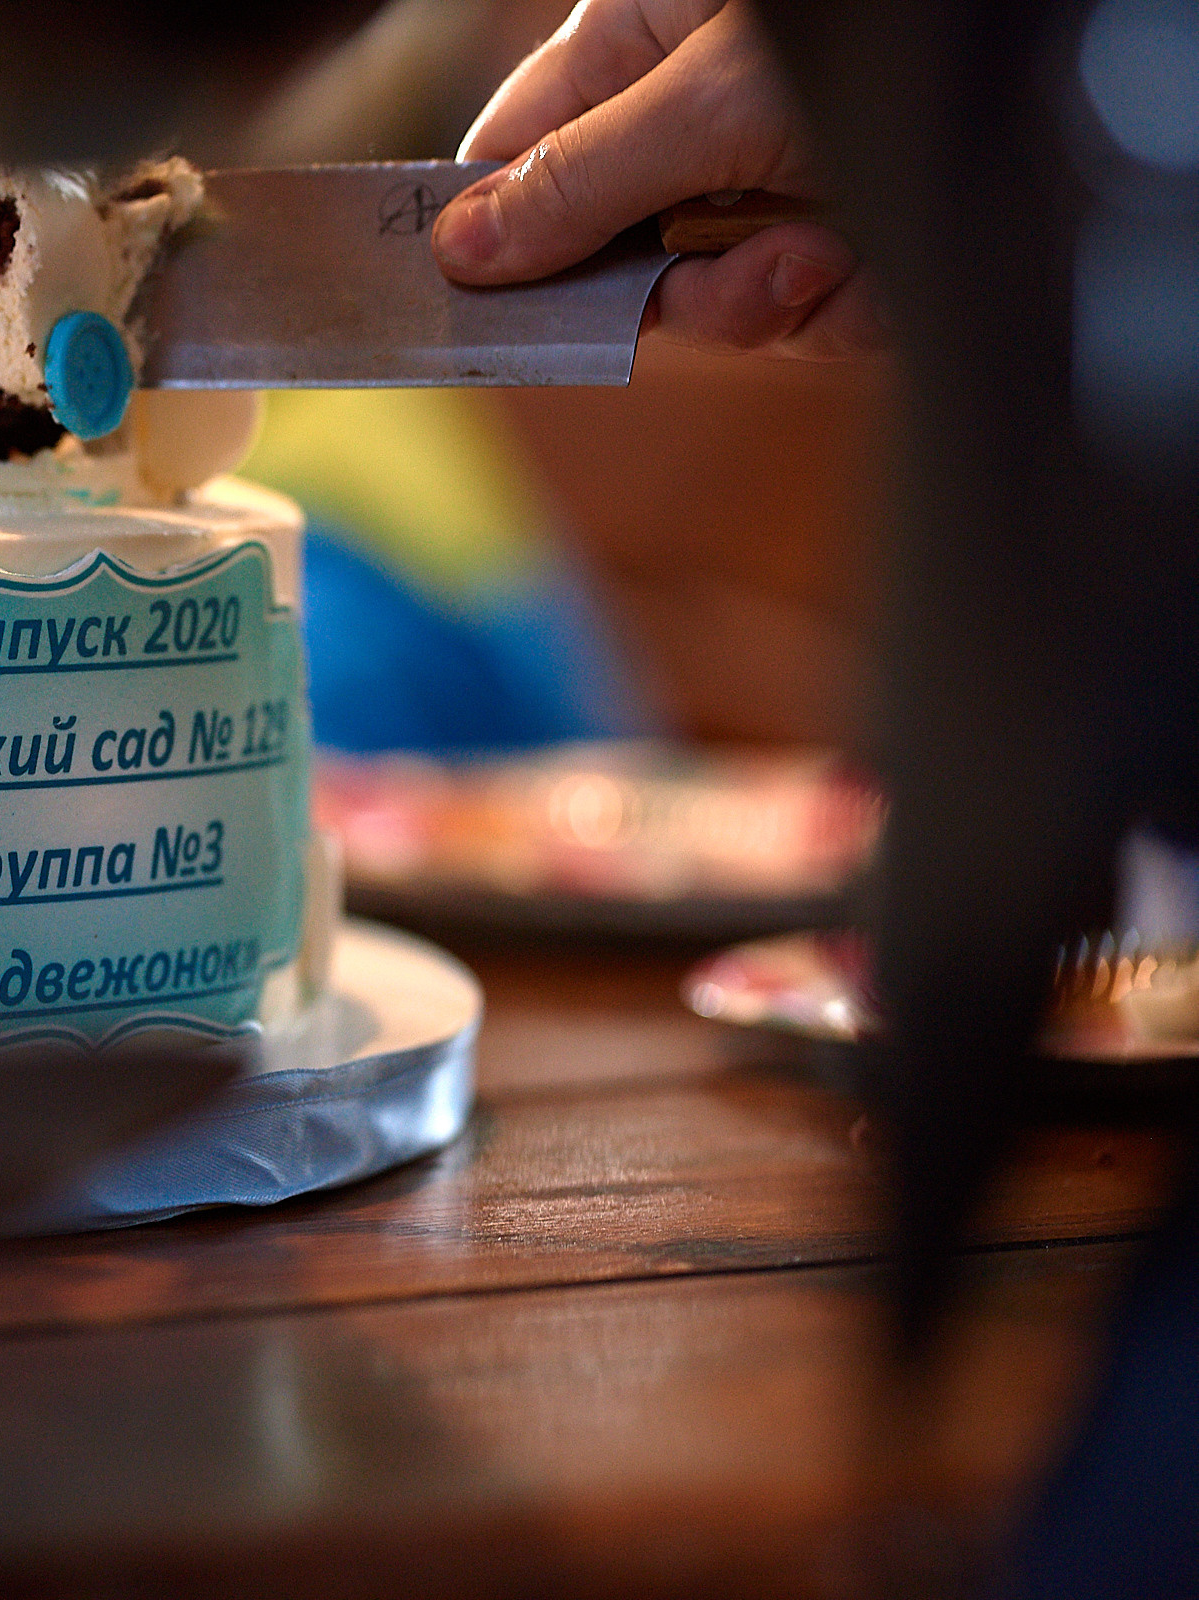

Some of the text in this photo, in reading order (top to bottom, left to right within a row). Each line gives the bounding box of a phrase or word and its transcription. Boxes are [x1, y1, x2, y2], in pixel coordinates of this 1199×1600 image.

[142, 594, 240, 655] 2020
[91, 709, 176, 773] сад
[187, 708, 234, 764] №
[149, 819, 226, 880] №3
